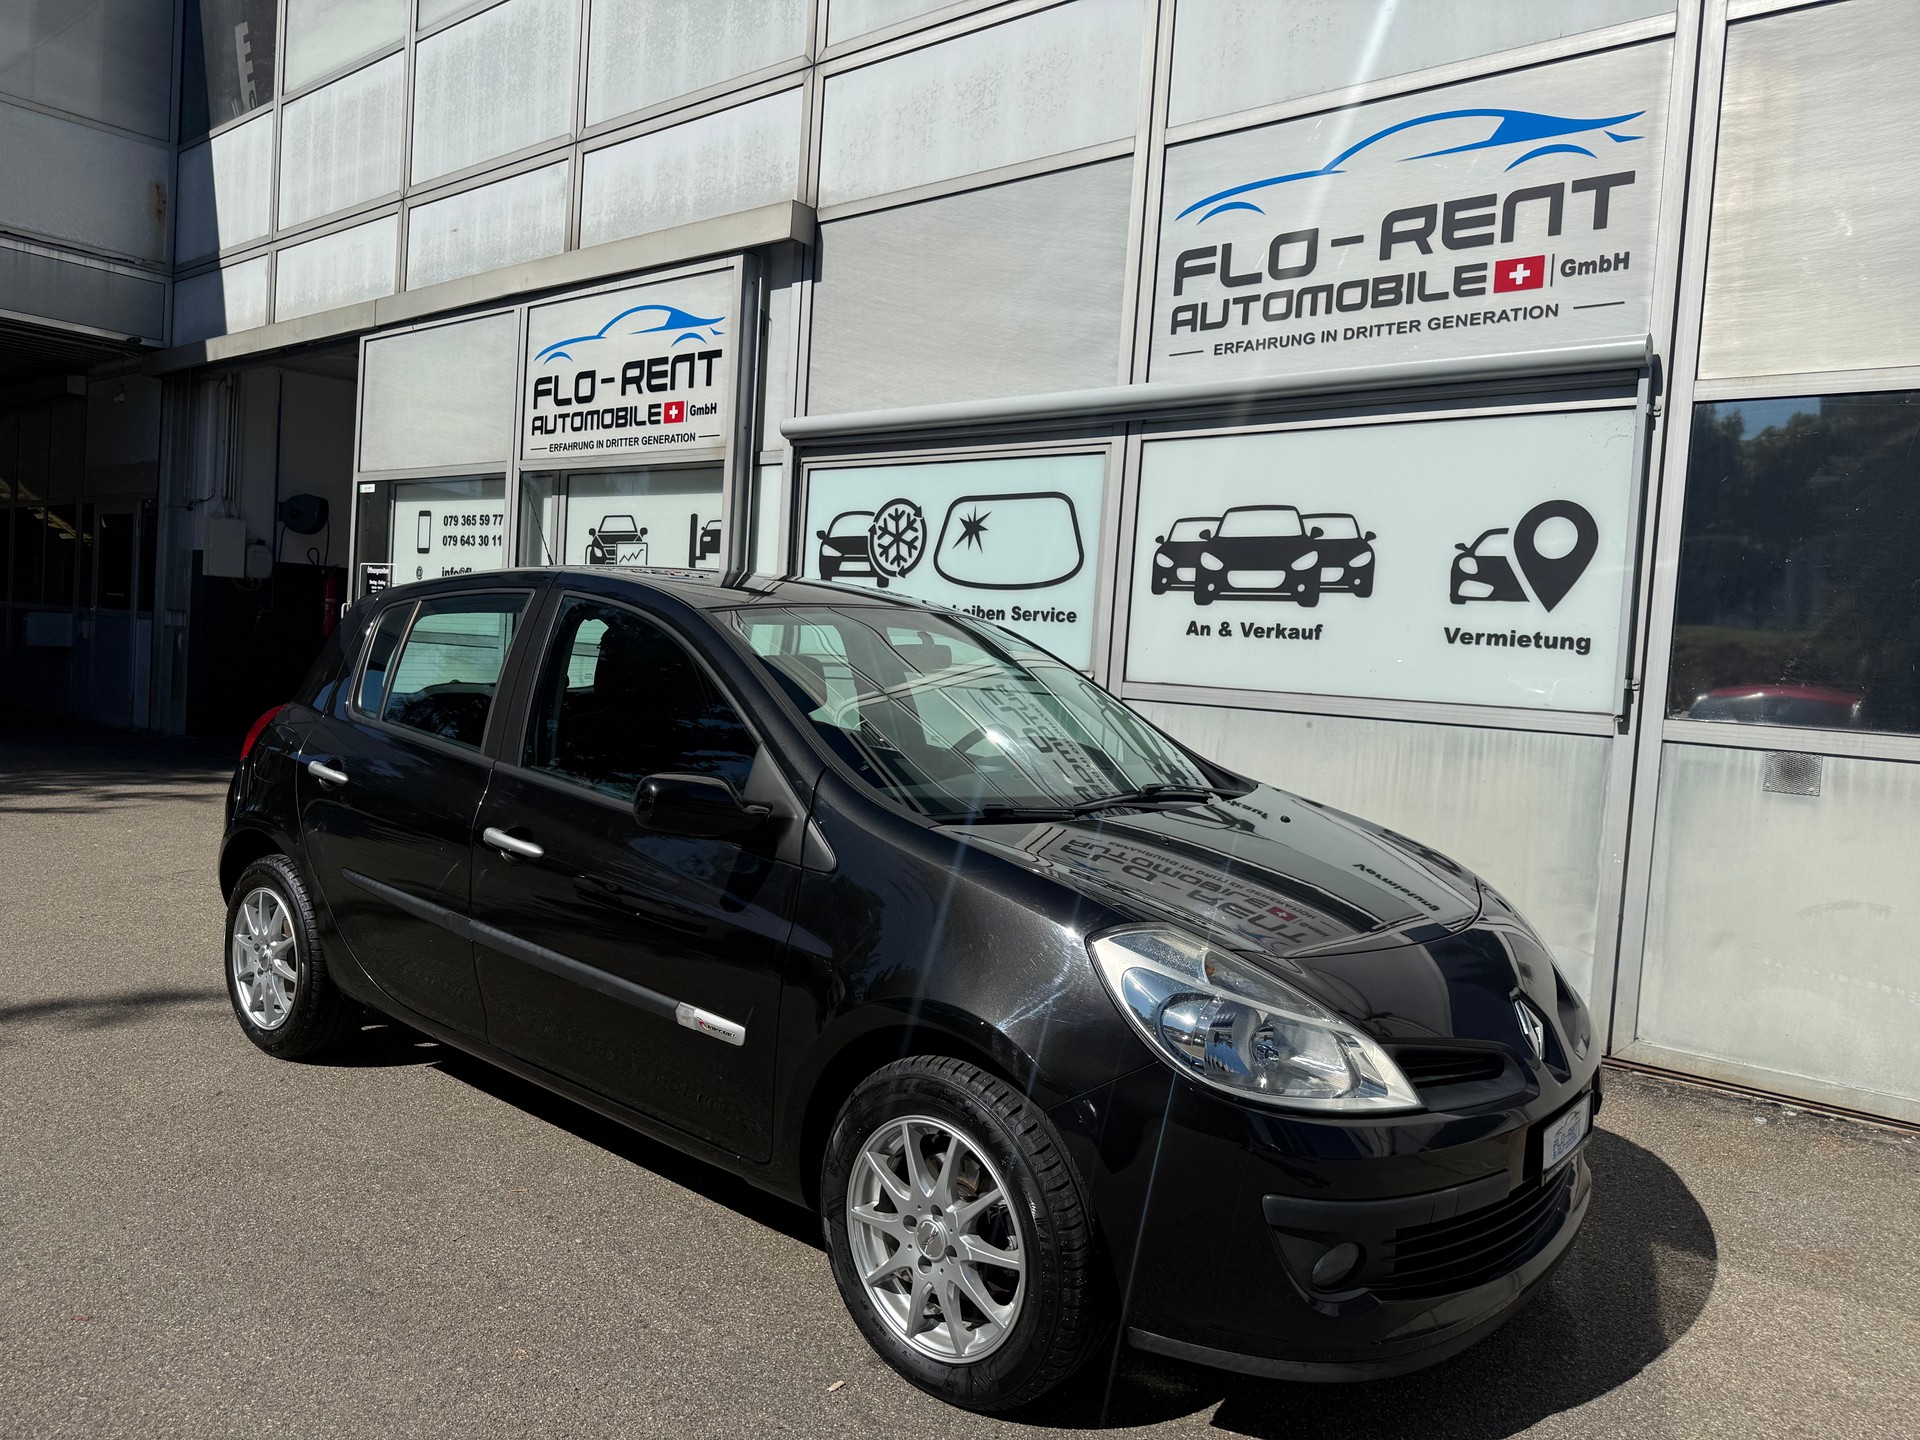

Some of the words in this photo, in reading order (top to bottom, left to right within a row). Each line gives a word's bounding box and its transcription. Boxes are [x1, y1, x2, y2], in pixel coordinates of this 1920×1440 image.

[1173, 170, 1636, 297] FLO-RENT
[1170, 262, 1488, 336] AUTOMOBILE
[1560, 251, 1630, 278] GmbH
[1213, 332, 1316, 356] ERFAHRUNG
[1320, 329, 1338, 344] IN
[1343, 319, 1422, 341] DRITTER
[1427, 303, 1559, 331] GENERATION
[532, 348, 723, 410] FLO-RENT
[531, 403, 662, 437] AUTOMOBILE
[689, 402, 718, 417] GmbH
[548, 440, 595, 453] ERFAHRUNG
[596, 439, 604, 449] IN
[605, 436, 640, 449] DRITTER
[641, 432, 696, 446] GENERATION
[443, 515, 459, 526] 079
[461, 515, 477, 526] 365
[479, 514, 490, 526] 59
[492, 514, 504, 526] 77
[442, 535, 458, 546] 079
[460, 535, 476, 546] 643
[478, 535, 489, 546] 30
[491, 534, 502, 546] 11
[1010, 605, 1078, 623] Service
[1185, 620, 1211, 637] An
[1218, 621, 1233, 638] &
[1240, 621, 1324, 641] Verkauf
[1443, 626, 1592, 656] Vermietung
